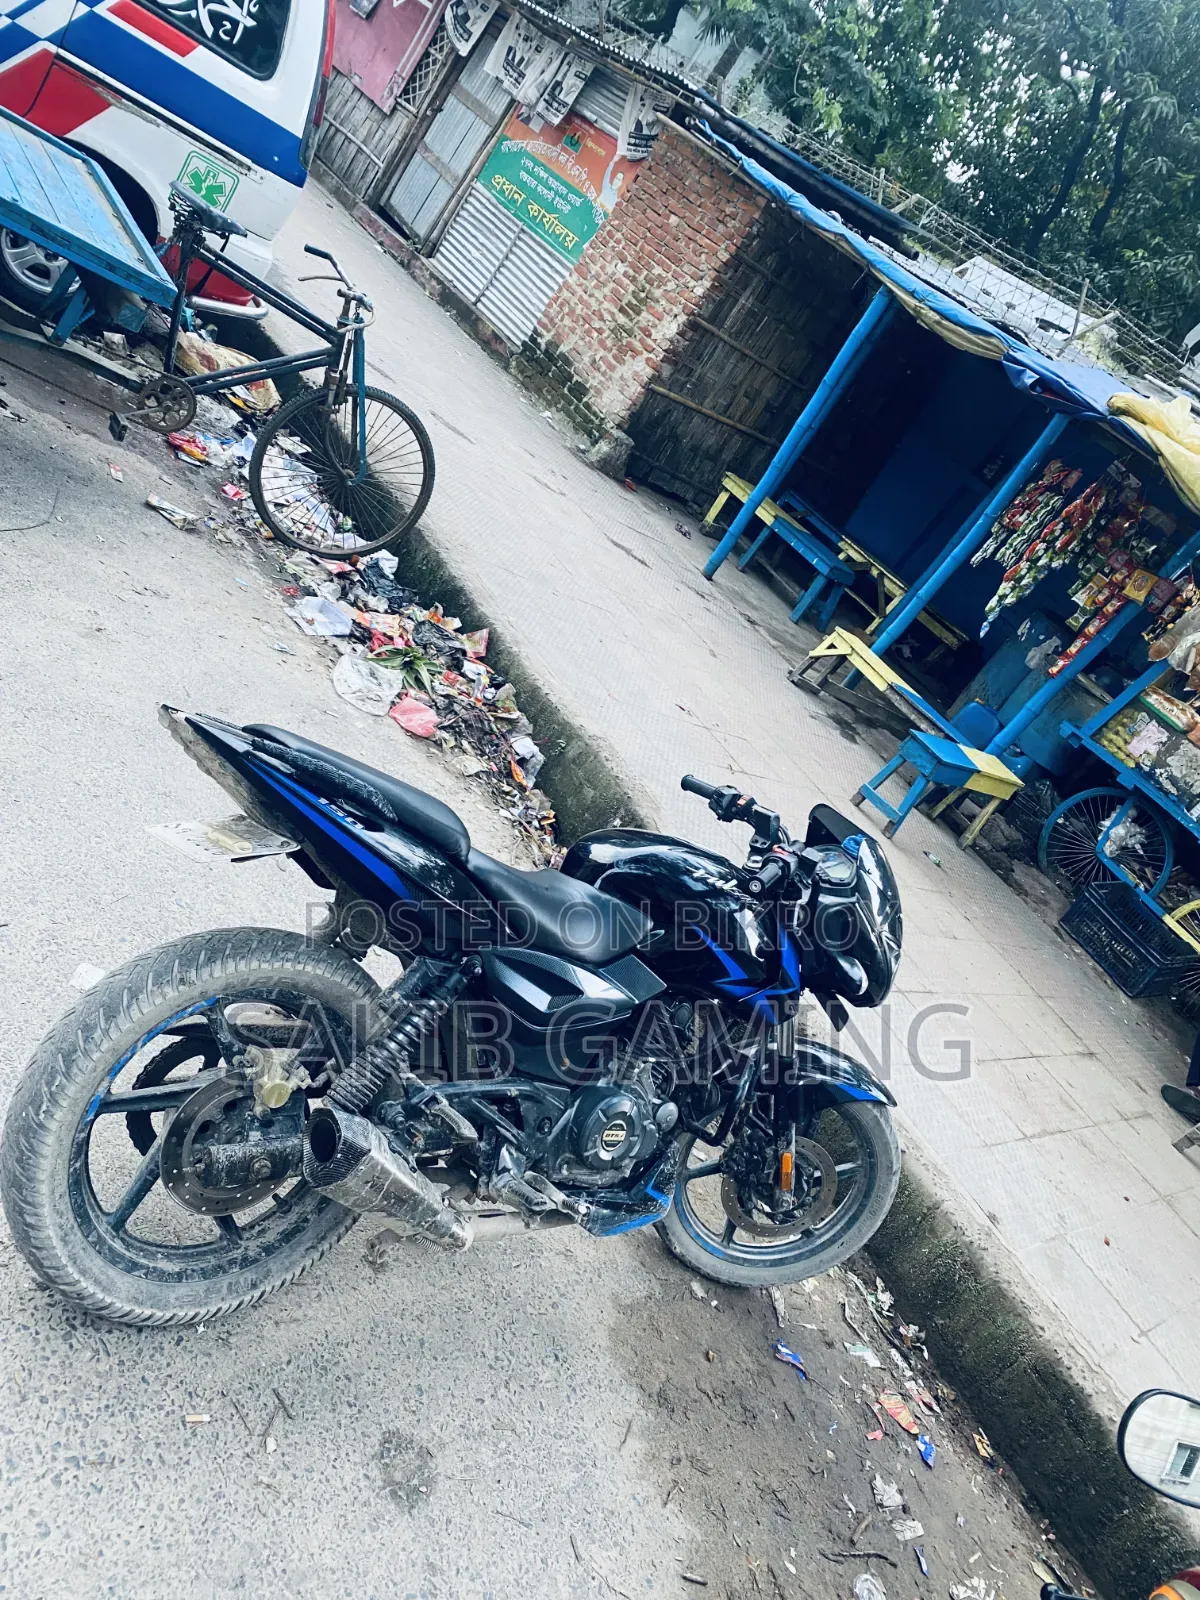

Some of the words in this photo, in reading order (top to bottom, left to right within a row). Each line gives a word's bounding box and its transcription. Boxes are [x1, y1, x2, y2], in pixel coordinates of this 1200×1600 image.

[491, 174, 527, 207] প্রধান
[528, 199, 580, 251] কার্যালয়
[316, 796, 366, 831] 150
